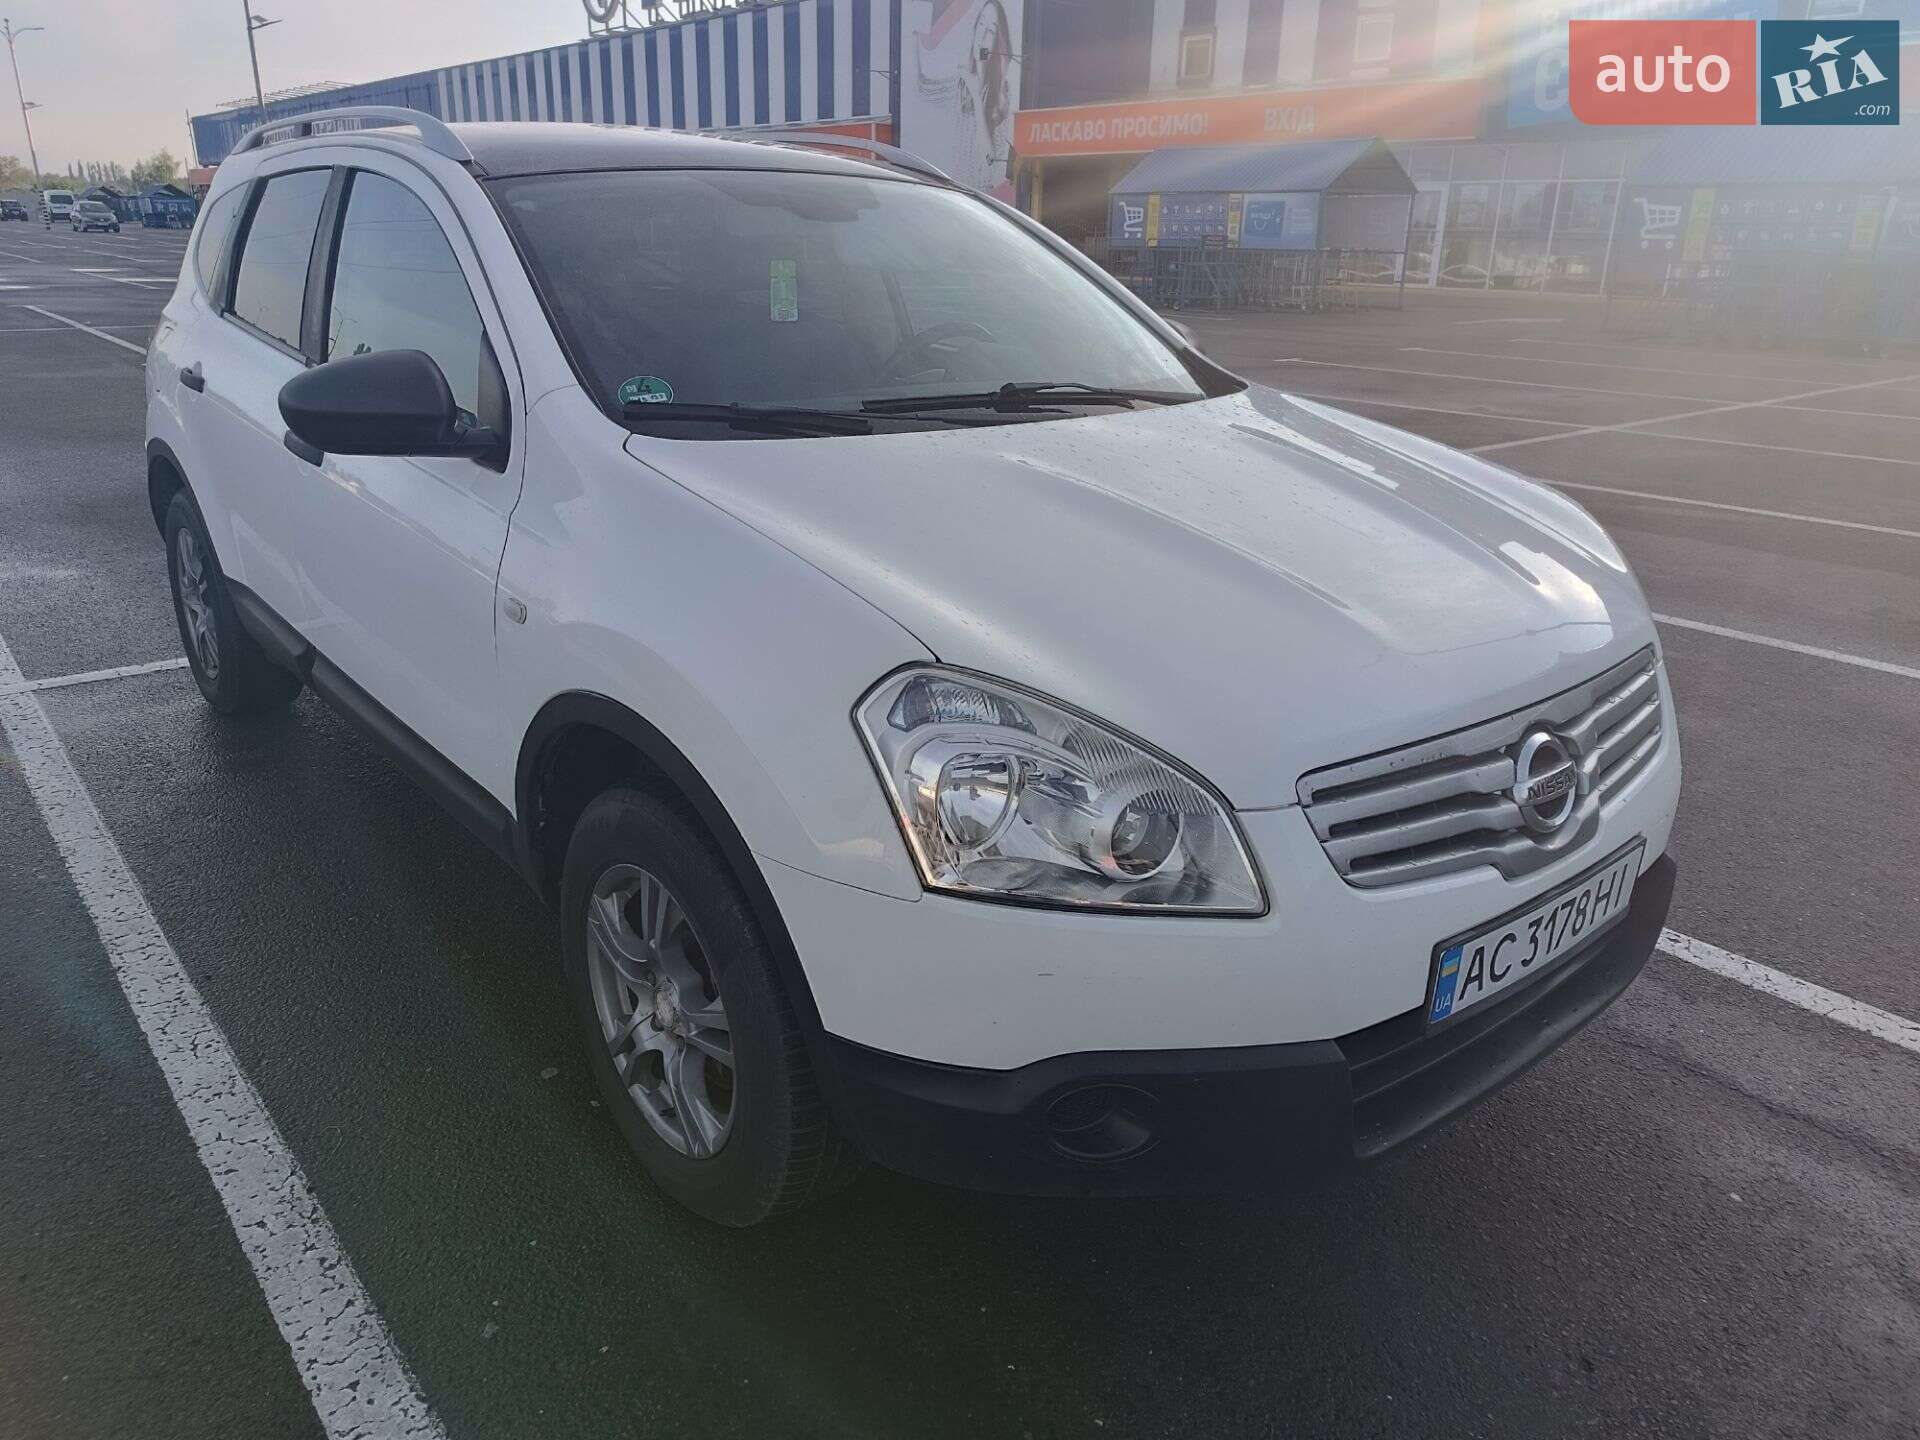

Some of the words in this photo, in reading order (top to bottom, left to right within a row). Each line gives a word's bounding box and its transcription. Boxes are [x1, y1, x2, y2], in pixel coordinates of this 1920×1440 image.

[1028, 119, 1106, 143] ЛАСКАВО
[1111, 113, 1208, 139] ПРОСИМО!
[1435, 995, 1451, 1013] UA
